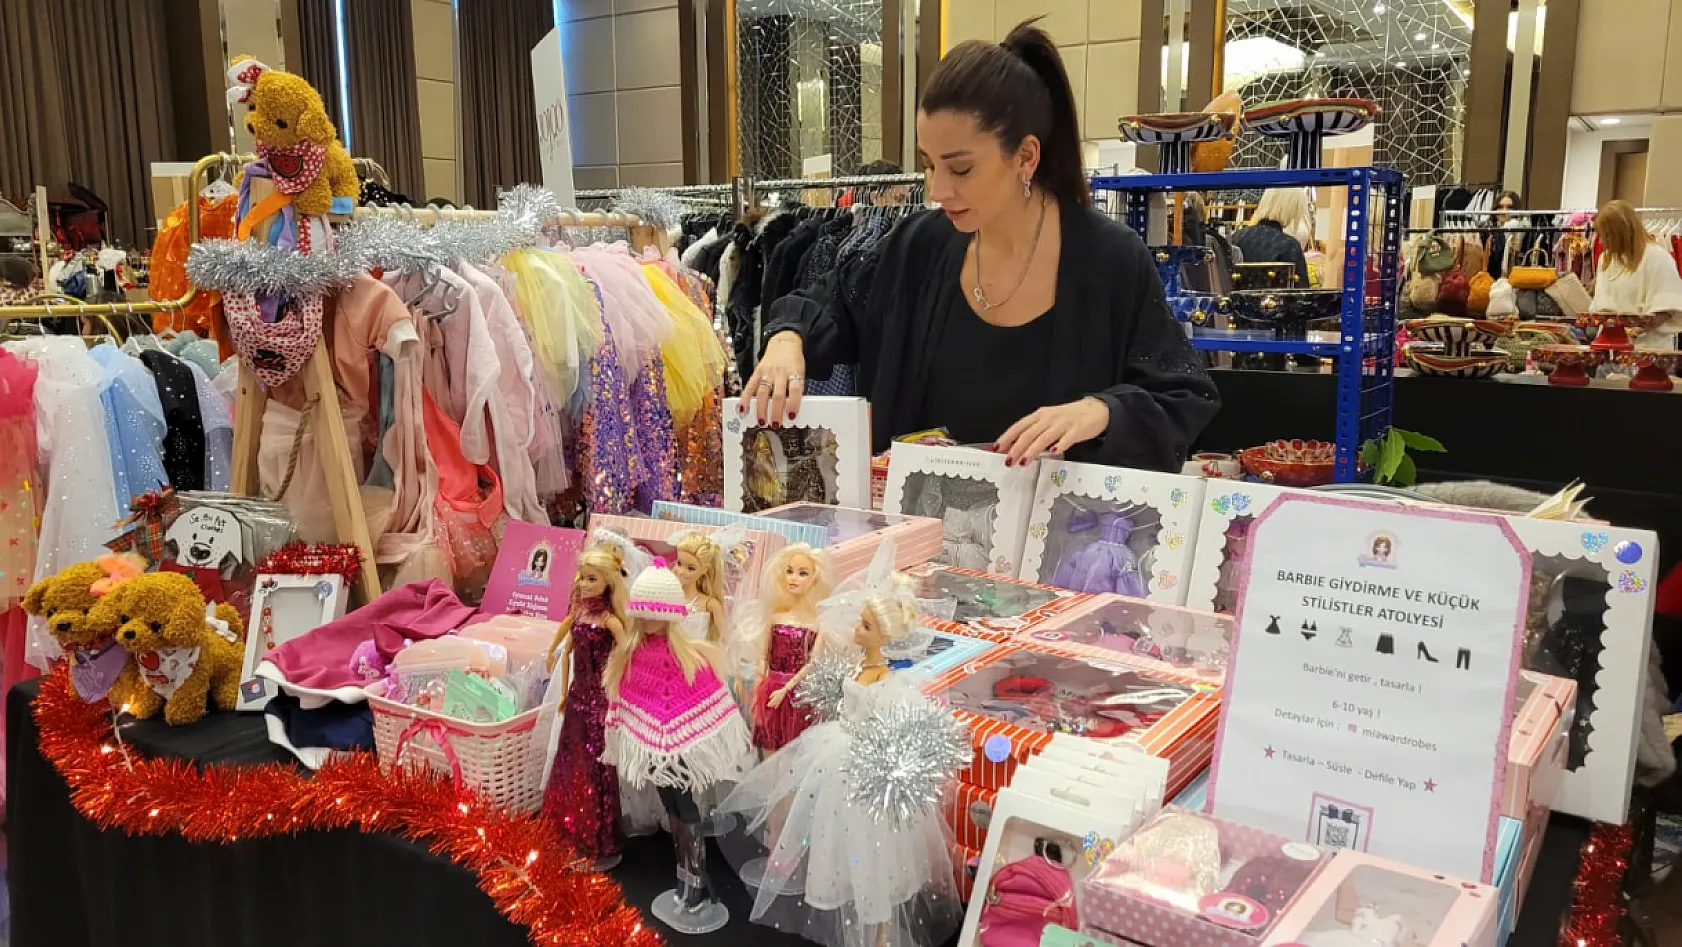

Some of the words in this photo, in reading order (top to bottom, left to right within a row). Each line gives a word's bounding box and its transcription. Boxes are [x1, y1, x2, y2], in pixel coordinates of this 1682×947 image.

[1277, 570, 1325, 587] BARBIE
[1329, 576, 1400, 598] GİYDİRME
[1405, 588, 1422, 602] VE
[1427, 590, 1480, 611] KÜÇÜK
[1301, 595, 1374, 618] STİLİSTLER
[1377, 607, 1444, 629] ATOLYESİ
[1347, 672, 1371, 683] getir
[1380, 678, 1415, 692] tasarla
[1332, 699, 1355, 713] 6-10
[1357, 705, 1374, 719] yaş
[1274, 707, 1315, 724] Detaylar
[1317, 717, 1334, 730] için
[1362, 727, 1437, 752] miawardrobes
[1282, 750, 1316, 766] Tasarla
[1326, 760, 1353, 775] Süsle
[1364, 769, 1395, 785] Defile
[1397, 776, 1417, 791] Yap
